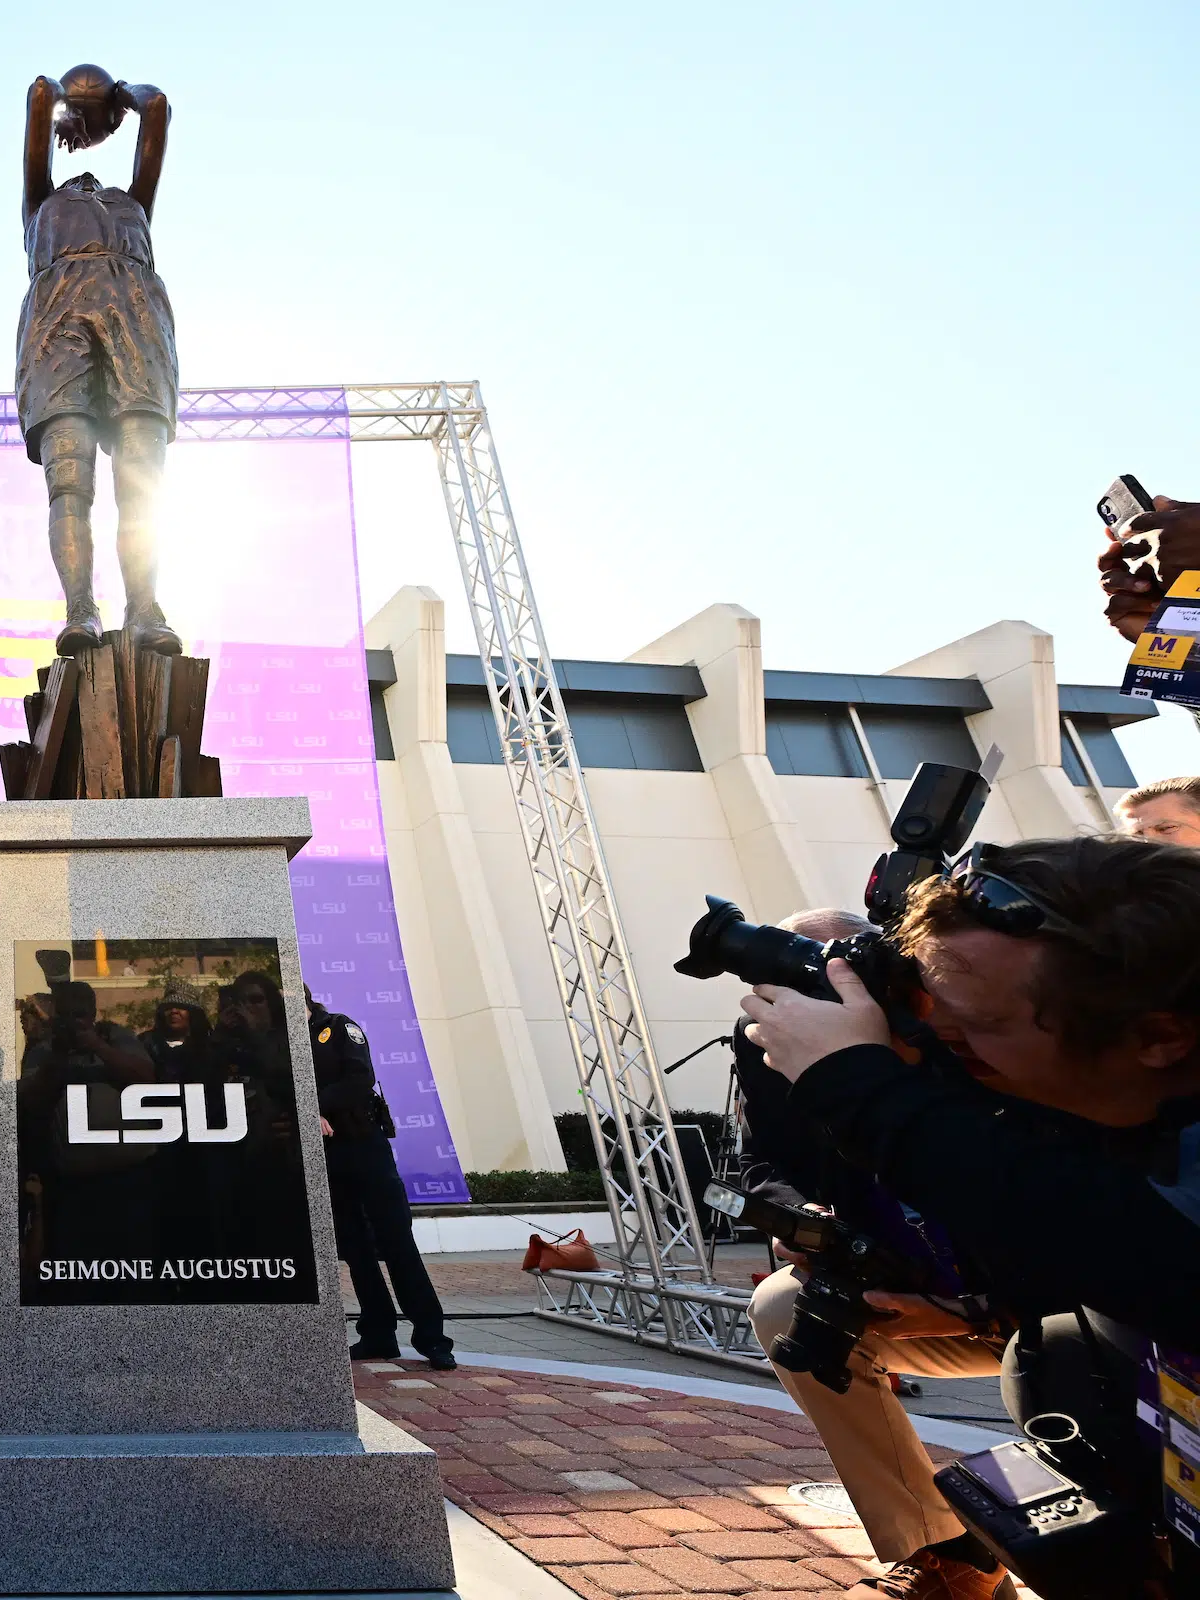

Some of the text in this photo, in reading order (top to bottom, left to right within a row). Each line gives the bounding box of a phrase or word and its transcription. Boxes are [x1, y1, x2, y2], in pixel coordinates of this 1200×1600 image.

[1148, 637, 1177, 653] M
[262, 657, 294, 668] LSU
[324, 656, 356, 667] LSU
[1136, 670, 1170, 680] GAME
[227, 684, 260, 694] LSU
[290, 684, 321, 694] LSU
[266, 712, 297, 721] LSU
[329, 710, 361, 720] LSU
[232, 736, 264, 747] LSU
[294, 736, 327, 747] LSU
[270, 764, 303, 776] LSU
[335, 764, 368, 775] LSU
[340, 817, 373, 831] LSU
[306, 845, 339, 857] LSU
[291, 875, 315, 887] SU
[348, 874, 380, 887] LSU
[312, 901, 347, 914] LSU
[299, 933, 323, 945] SU
[356, 932, 390, 944] LSU
[320, 960, 356, 973] LSU
[365, 991, 401, 1003] LSU
[380, 1052, 417, 1065] LSU
[66, 1082, 248, 1143] LSU
[394, 1113, 435, 1129] LSU
[413, 1181, 456, 1195] LSU
[39, 1258, 296, 1280] SEIMONE AUGUSTUS
